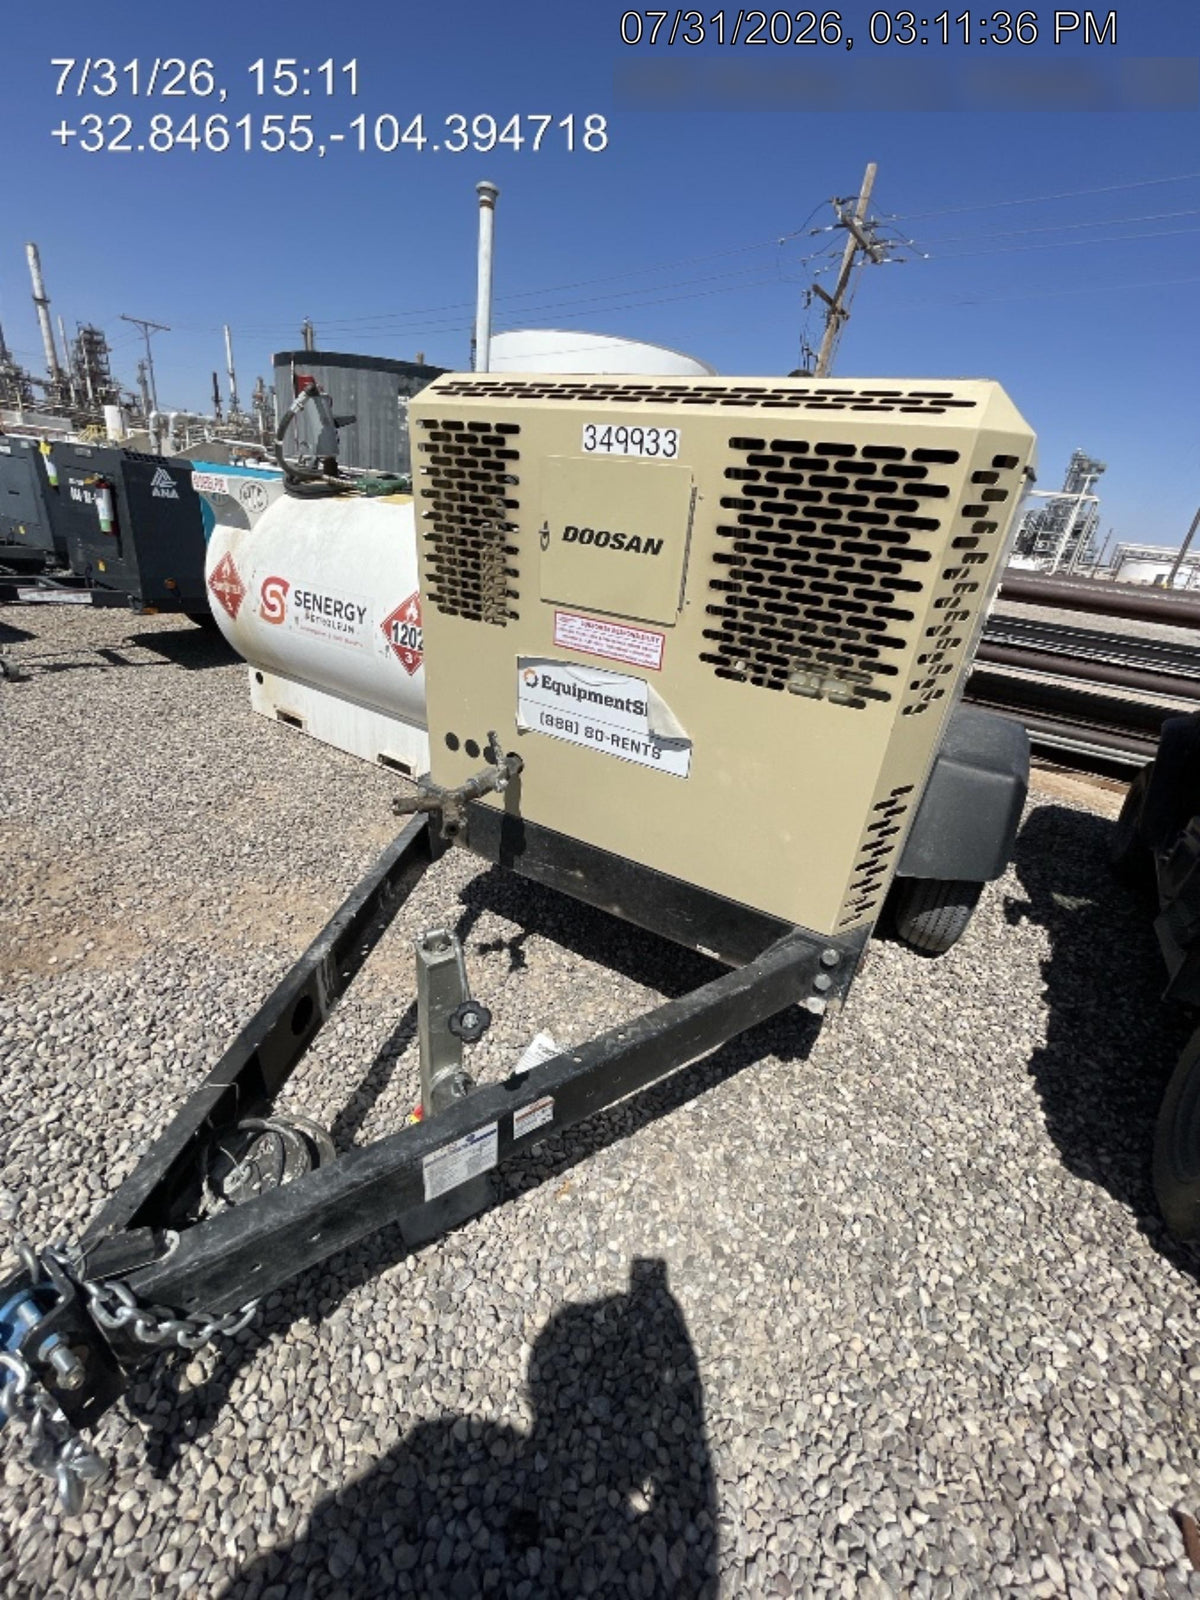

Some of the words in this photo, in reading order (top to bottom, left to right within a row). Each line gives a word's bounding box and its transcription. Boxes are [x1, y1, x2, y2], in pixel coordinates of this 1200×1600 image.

[584, 424, 678, 458] 349933
[562, 526, 664, 556] DOOSAN
[294, 589, 367, 625] SENERGY
[540, 711, 579, 735] (888)
[584, 726, 662, 760] 80-RENTS
